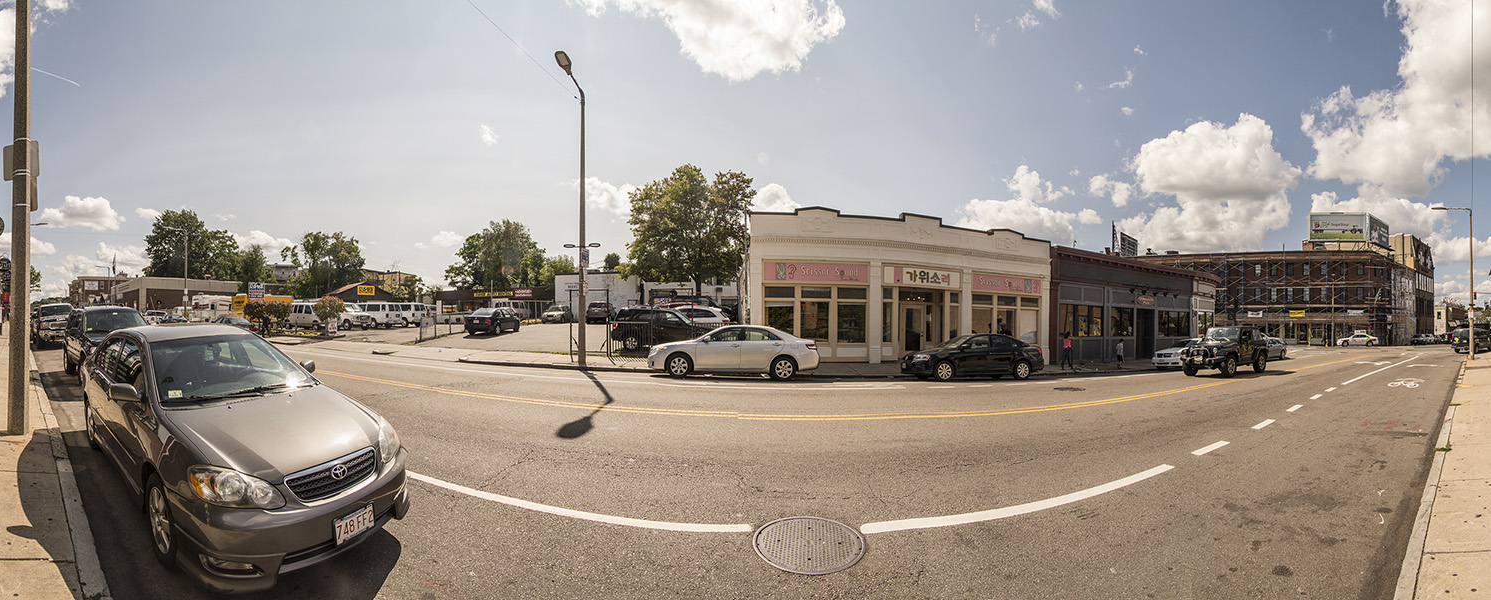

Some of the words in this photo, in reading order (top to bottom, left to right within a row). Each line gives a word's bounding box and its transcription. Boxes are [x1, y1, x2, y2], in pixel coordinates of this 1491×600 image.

[800, 265, 829, 276] Scissor
[835, 266, 859, 277] Sound
[906, 270, 950, 286] 가위소리
[979, 276, 1001, 286] Scissor
[336, 519, 355, 540] 748
[356, 510, 374, 529] FF2
